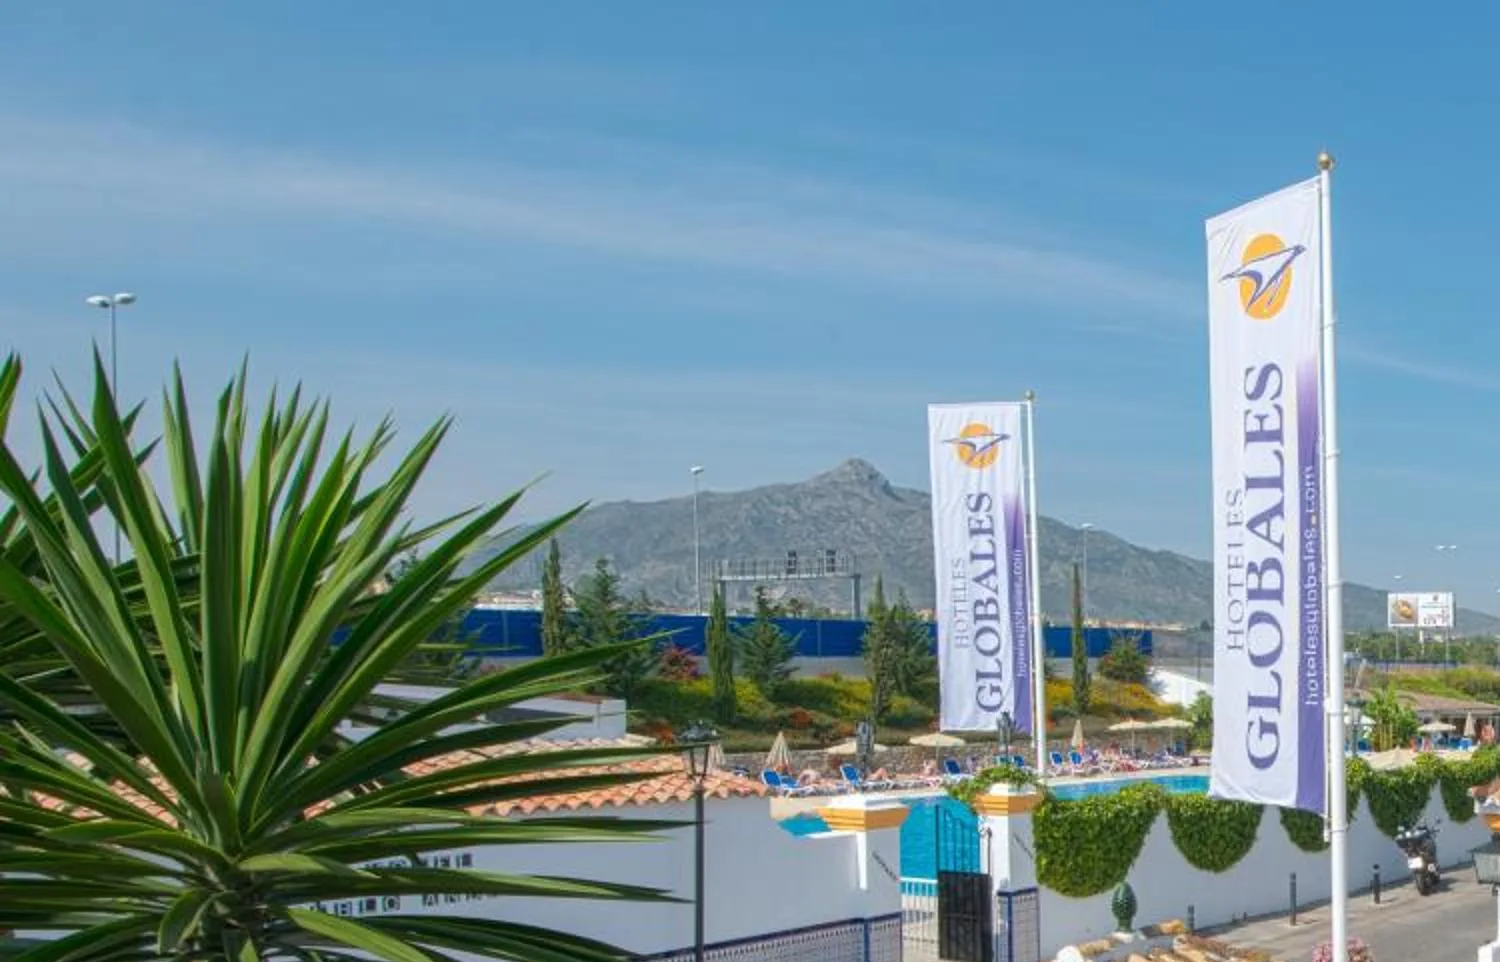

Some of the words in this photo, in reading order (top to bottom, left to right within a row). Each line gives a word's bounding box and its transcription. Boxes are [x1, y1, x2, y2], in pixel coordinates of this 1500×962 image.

[952, 557, 969, 650] HOTELES
[967, 491, 1004, 713] GLOBALES
[1227, 488, 1246, 652] HOTELES
[1243, 361, 1286, 771] GLOBALES
